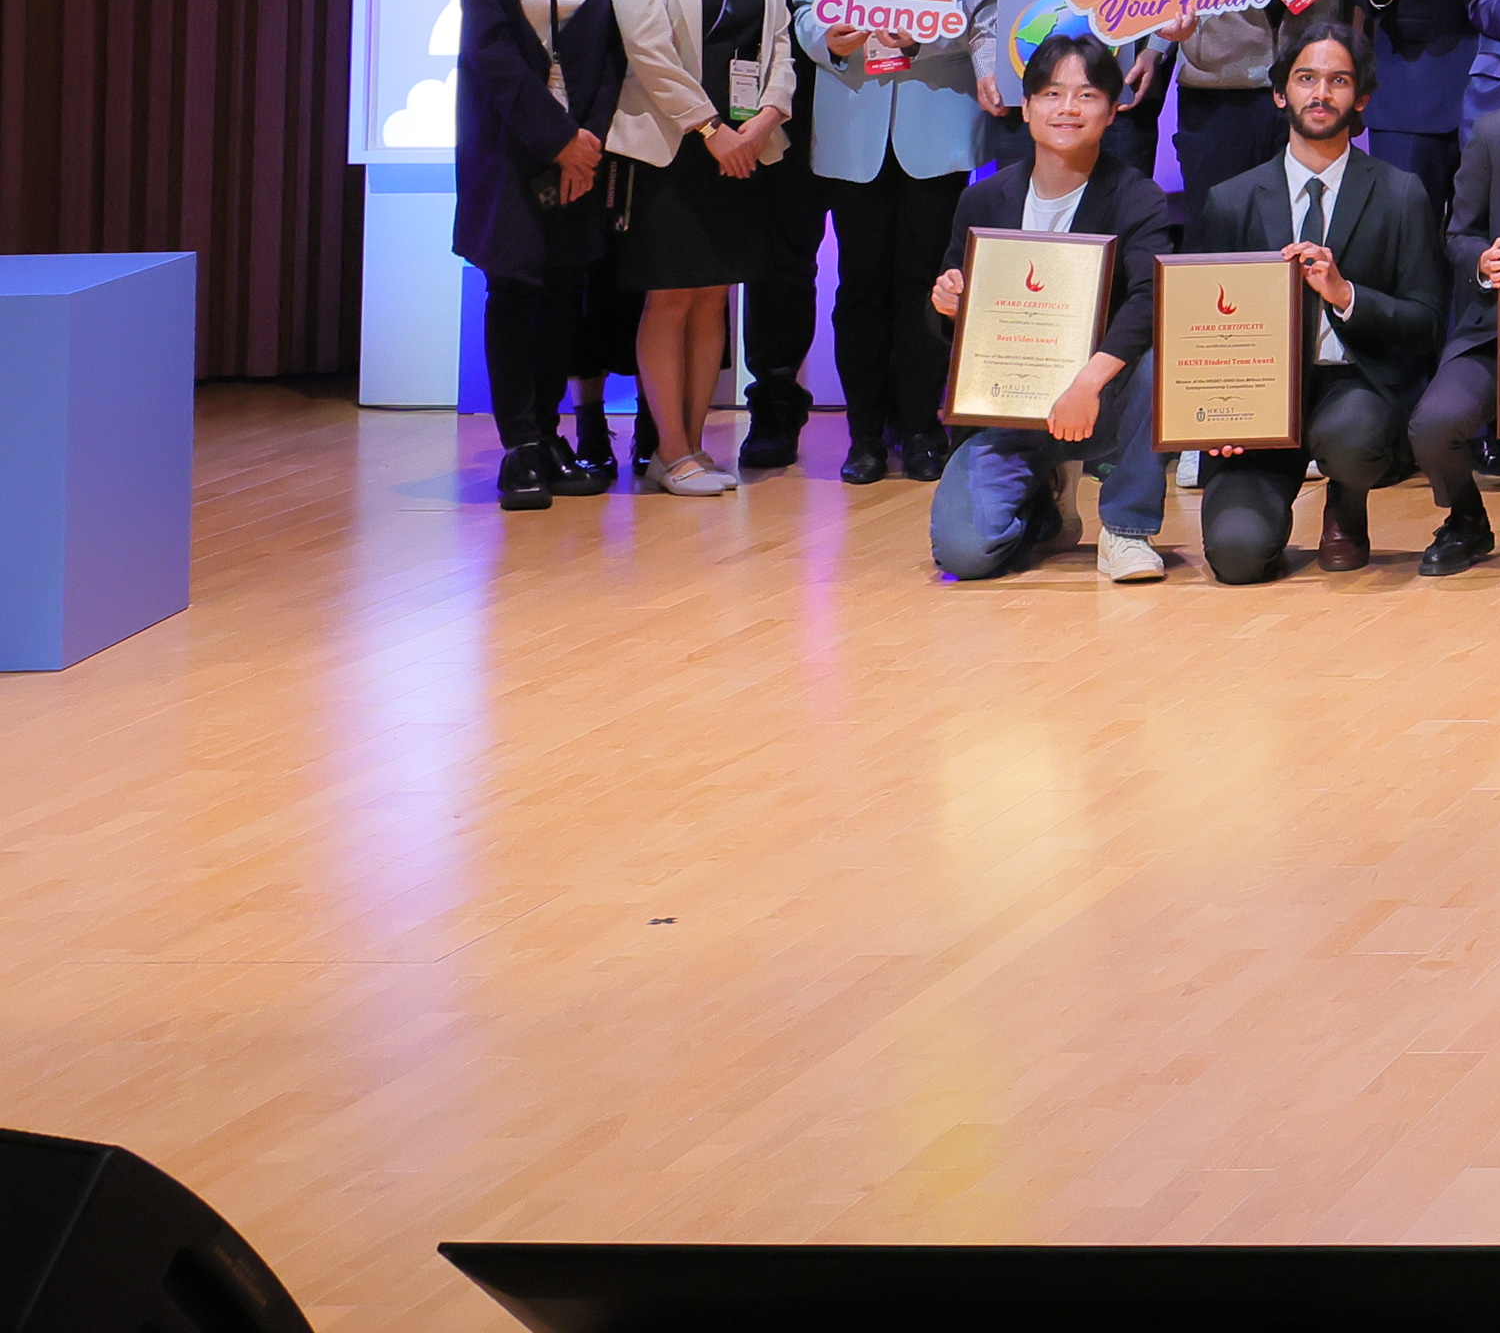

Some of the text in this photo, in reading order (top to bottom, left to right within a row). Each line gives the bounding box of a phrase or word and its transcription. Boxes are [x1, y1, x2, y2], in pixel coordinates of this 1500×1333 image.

[996, 334, 1059, 345] Best Video Award
[1178, 359, 1203, 367] HKUST
[1204, 358, 1231, 366] Student
[1252, 357, 1274, 365] Award
